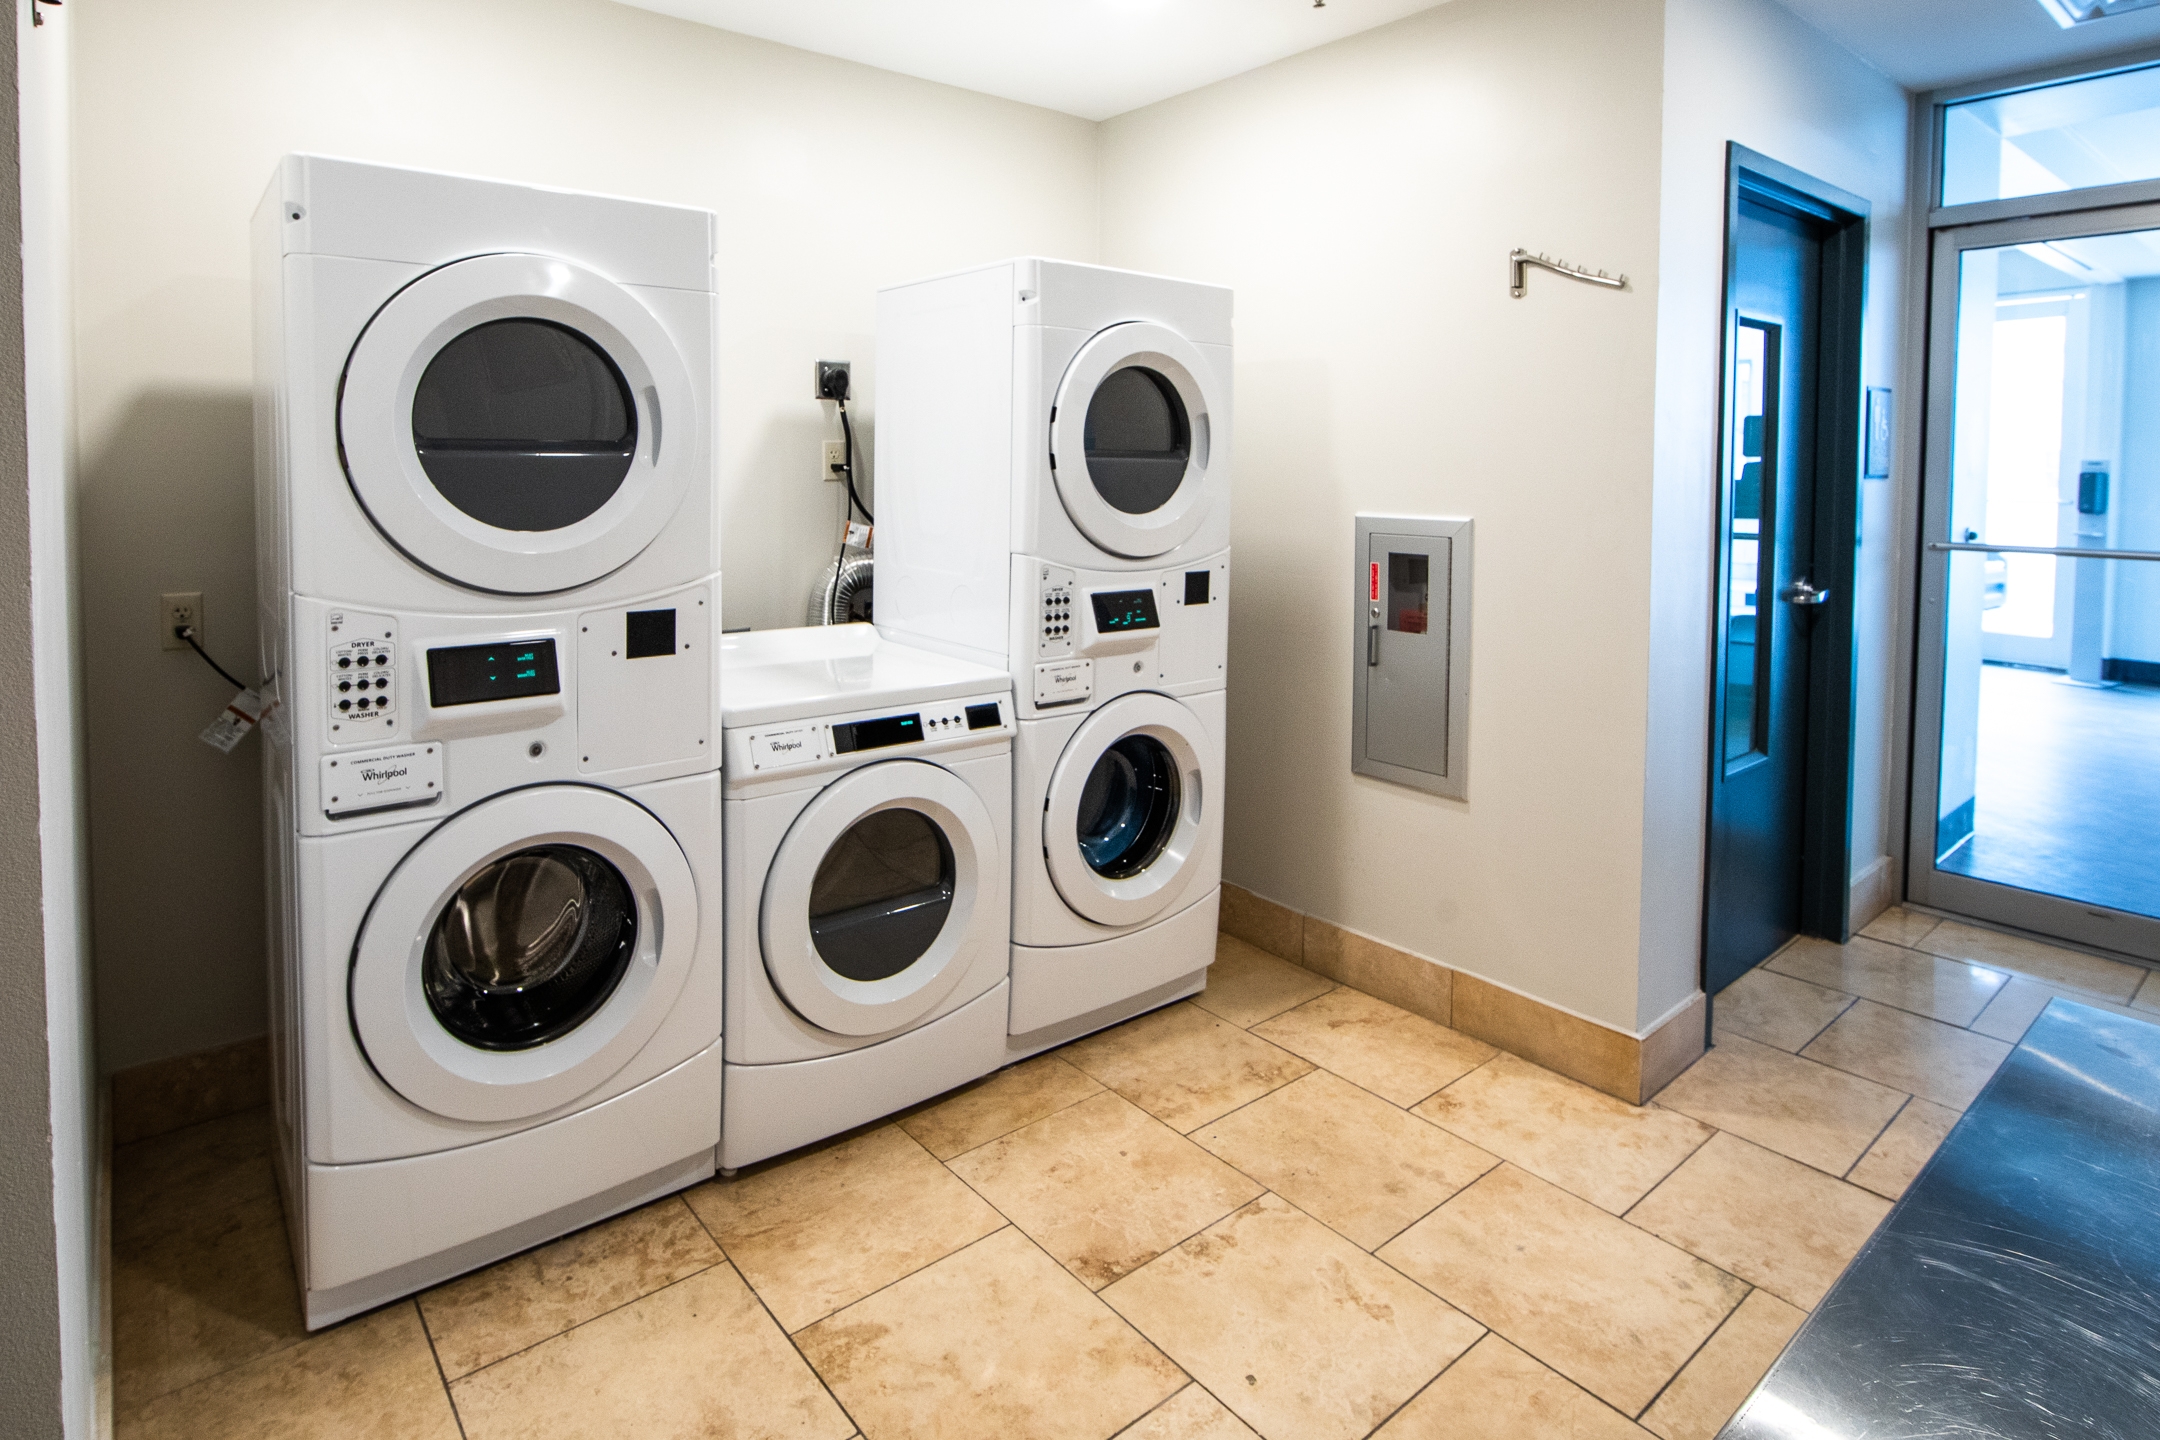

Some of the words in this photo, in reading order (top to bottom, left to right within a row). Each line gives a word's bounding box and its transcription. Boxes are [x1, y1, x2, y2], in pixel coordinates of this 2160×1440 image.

[1055, 675, 1077, 683] Whirlpool
[348, 711, 379, 720] WASHER
[771, 741, 802, 751] Whirlpool
[362, 767, 407, 781] Whirlpool
